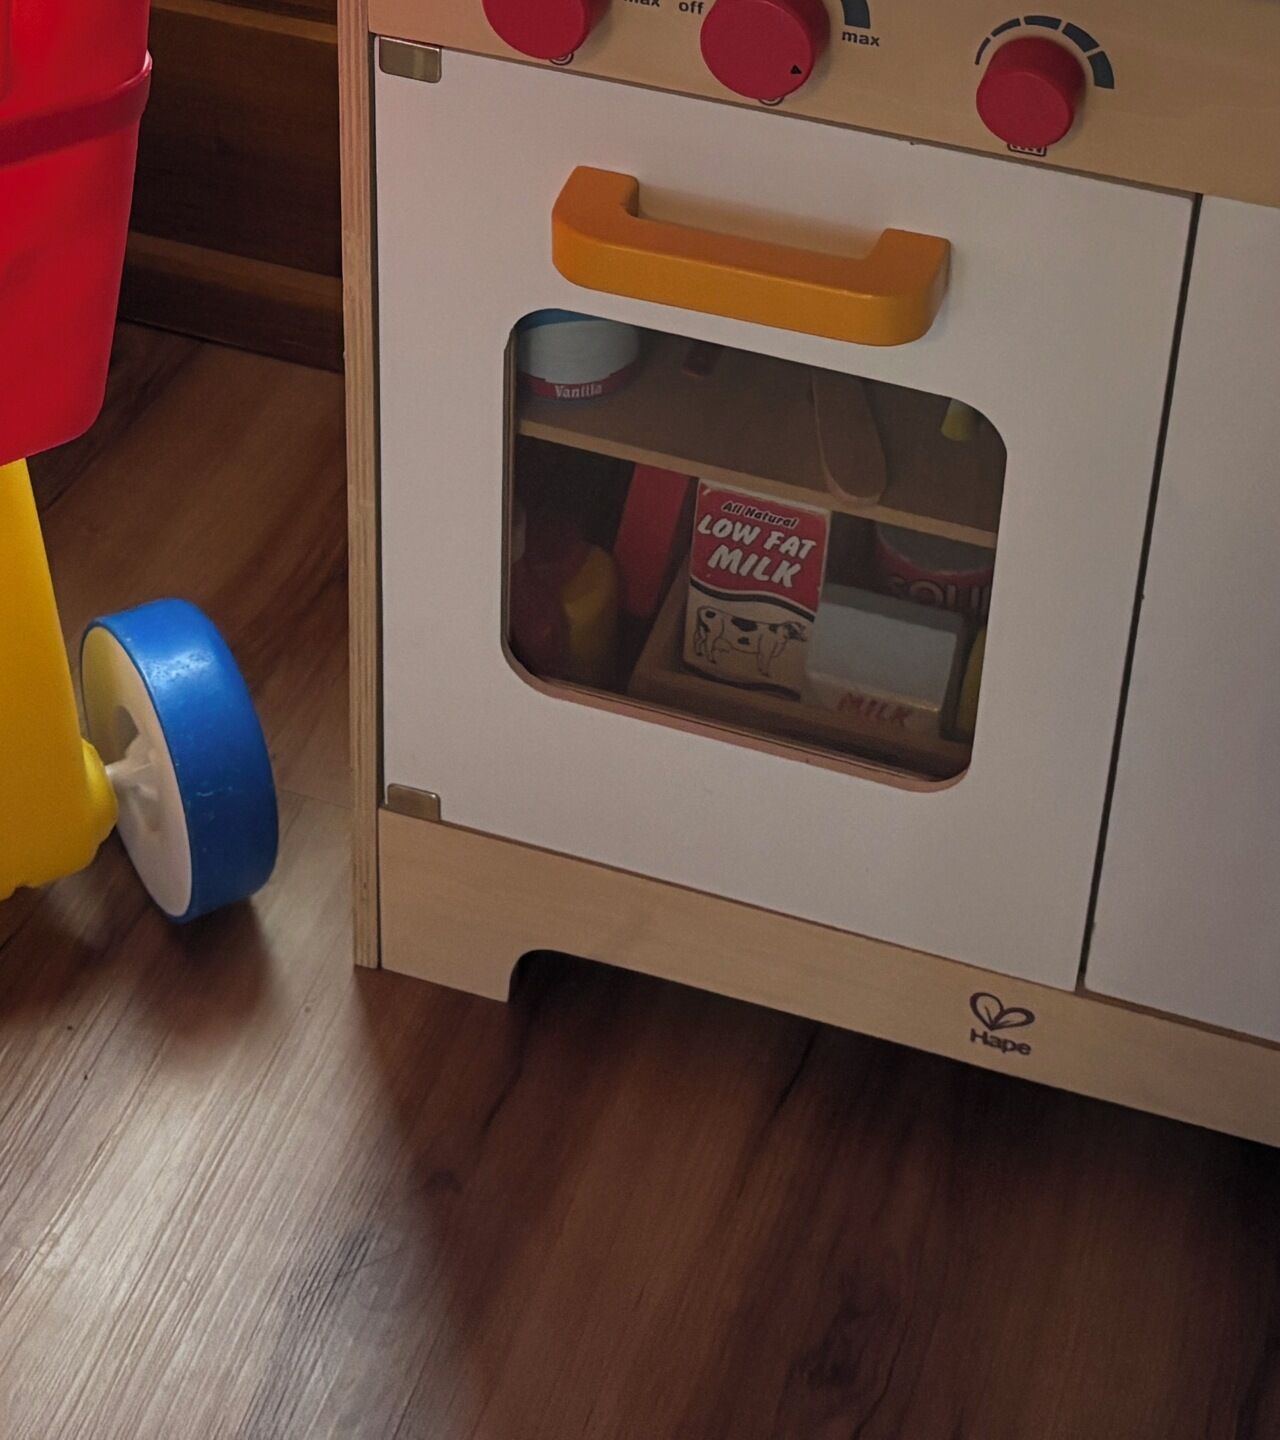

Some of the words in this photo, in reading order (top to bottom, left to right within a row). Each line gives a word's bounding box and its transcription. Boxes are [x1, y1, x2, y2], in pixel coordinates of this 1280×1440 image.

[678, 1, 704, 15] off
[842, 30, 881, 48] max
[554, 384, 603, 398] Vanilla
[721, 500, 745, 516] All
[745, 507, 800, 529] Natural
[697, 514, 762, 546] LOW
[763, 530, 817, 560] FAT
[707, 545, 802, 588] MILK
[970, 1028, 1032, 1056] Hape
